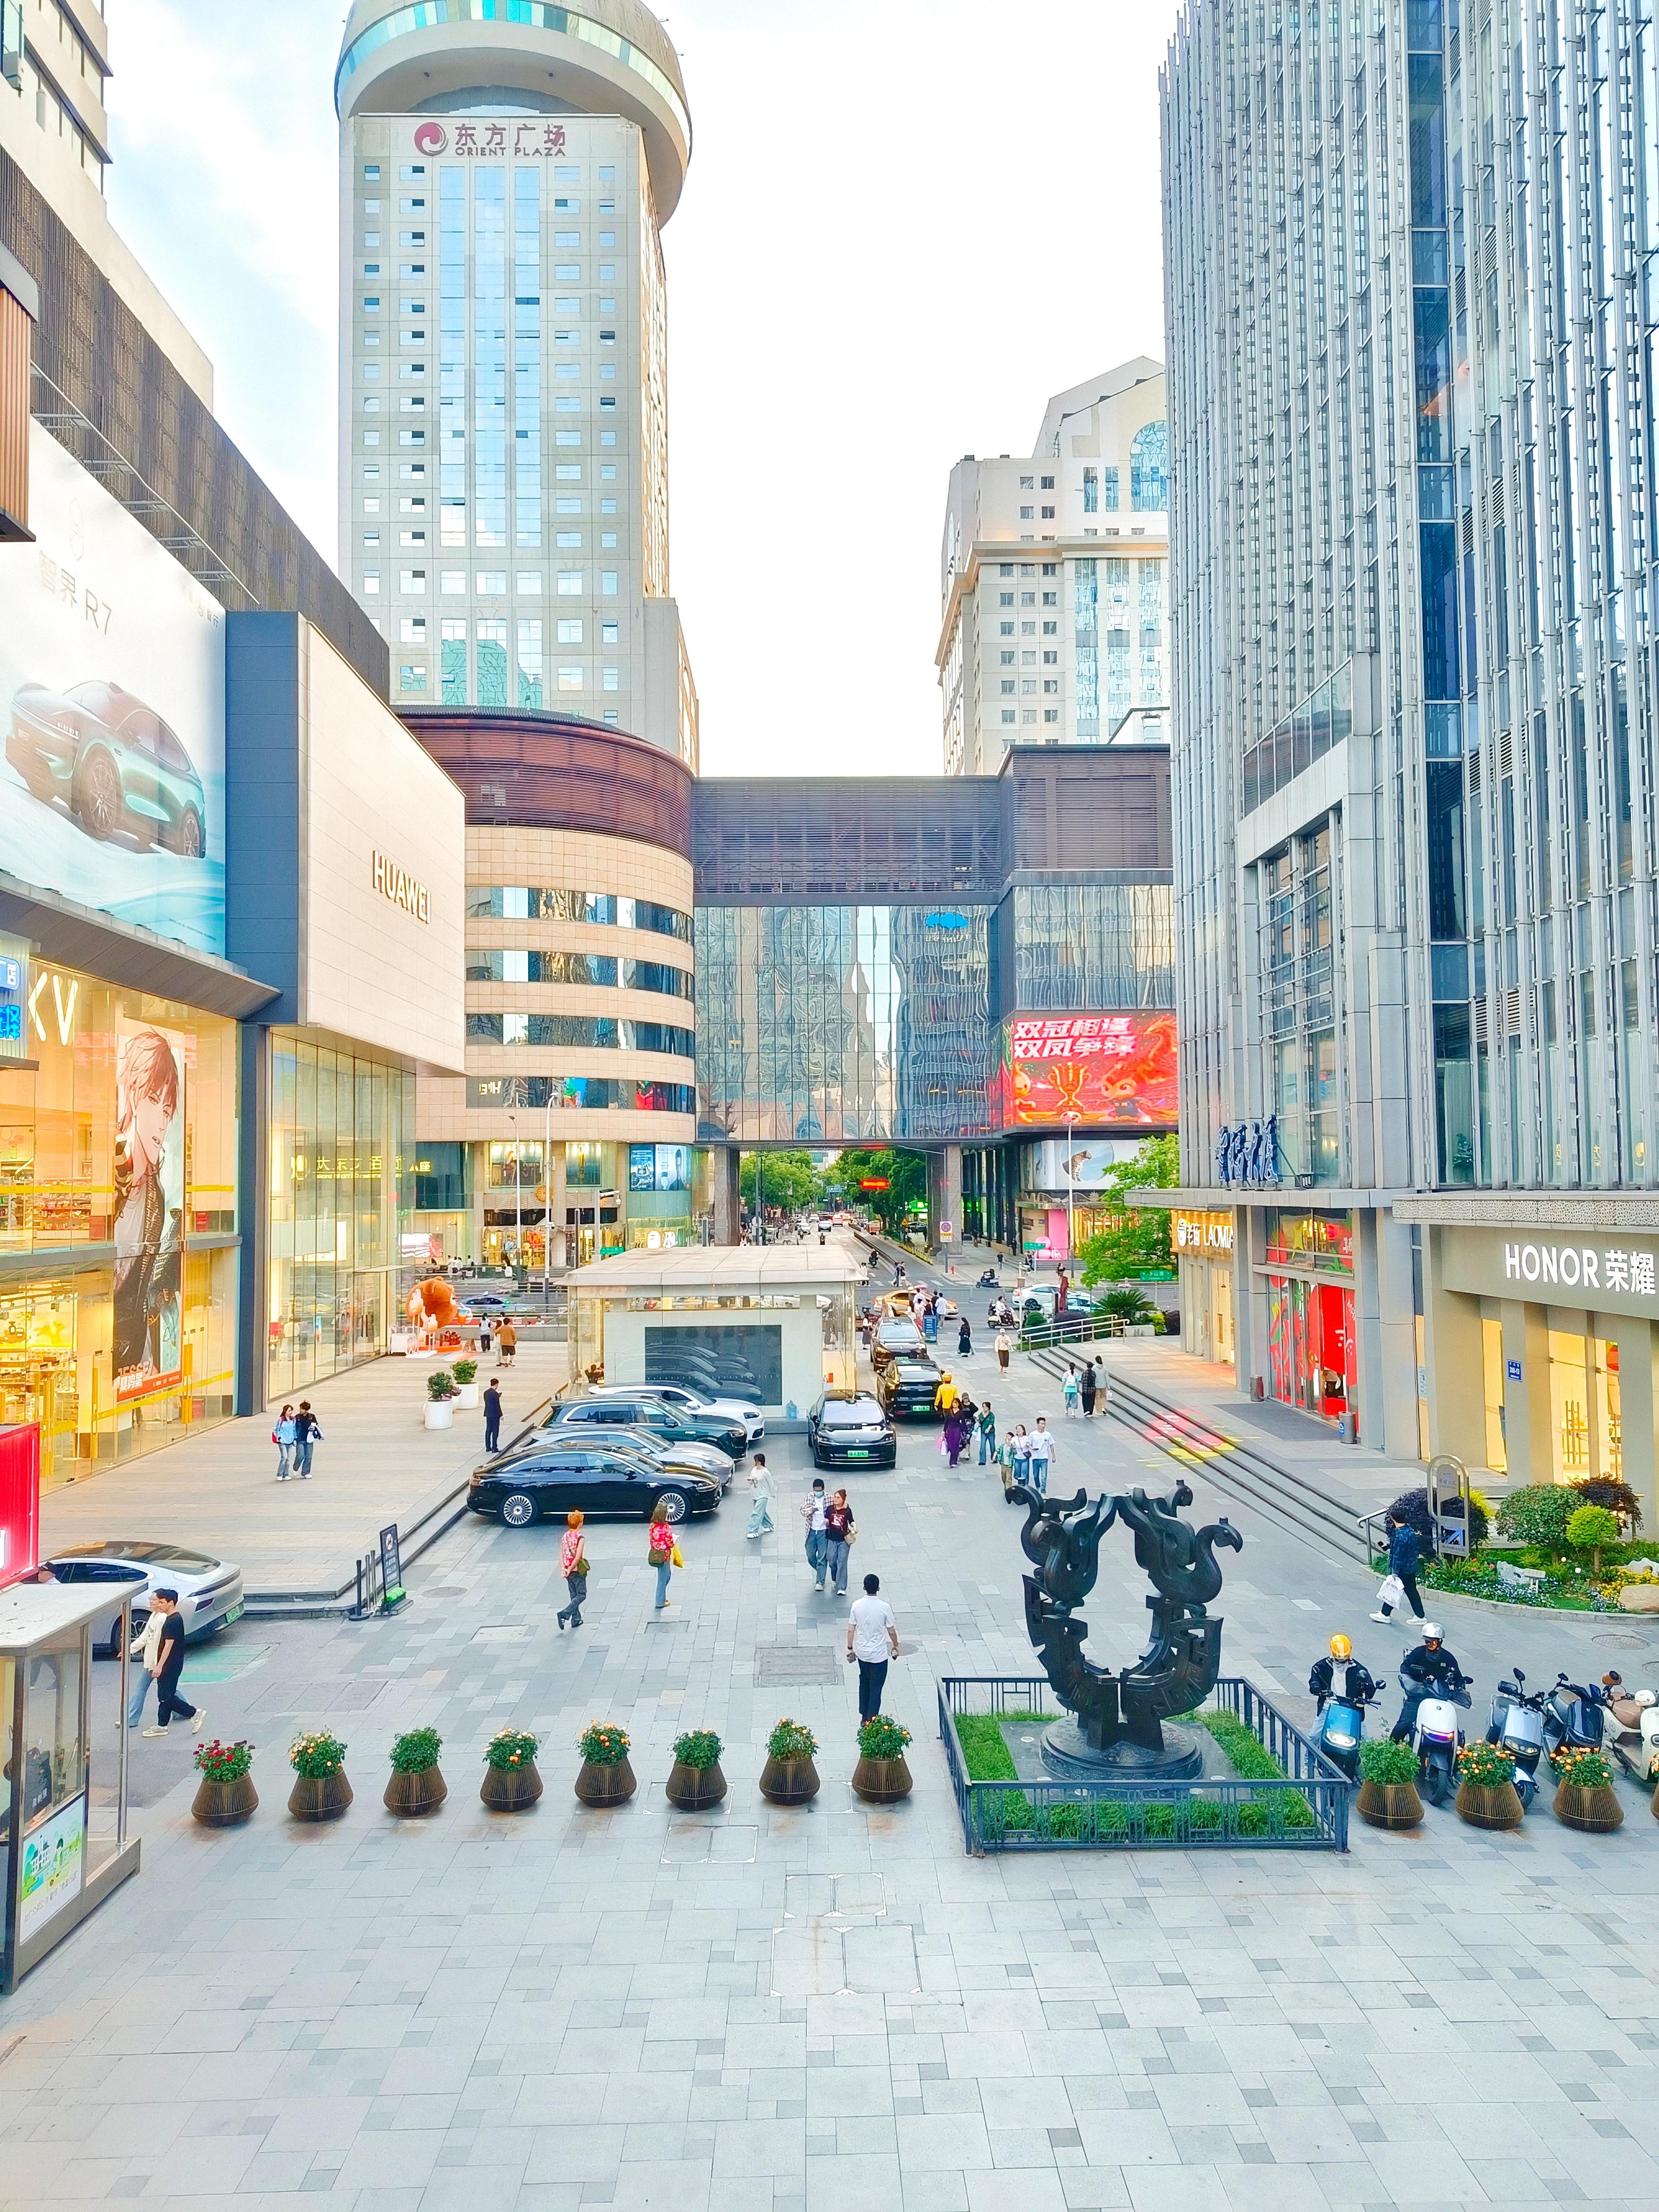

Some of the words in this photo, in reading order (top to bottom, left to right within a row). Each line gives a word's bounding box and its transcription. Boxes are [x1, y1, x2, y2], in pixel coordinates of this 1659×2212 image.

[455, 123, 566, 146] 东方广场
[455, 147, 505, 156] ORIENT
[514, 147, 566, 156] PLAZA
[85, 587, 112, 636] R7
[373, 849, 431, 924] HUAWEI
[1506, 1244, 1600, 1288] HONOR
[1605, 1249, 1656, 1295] 荣耀
